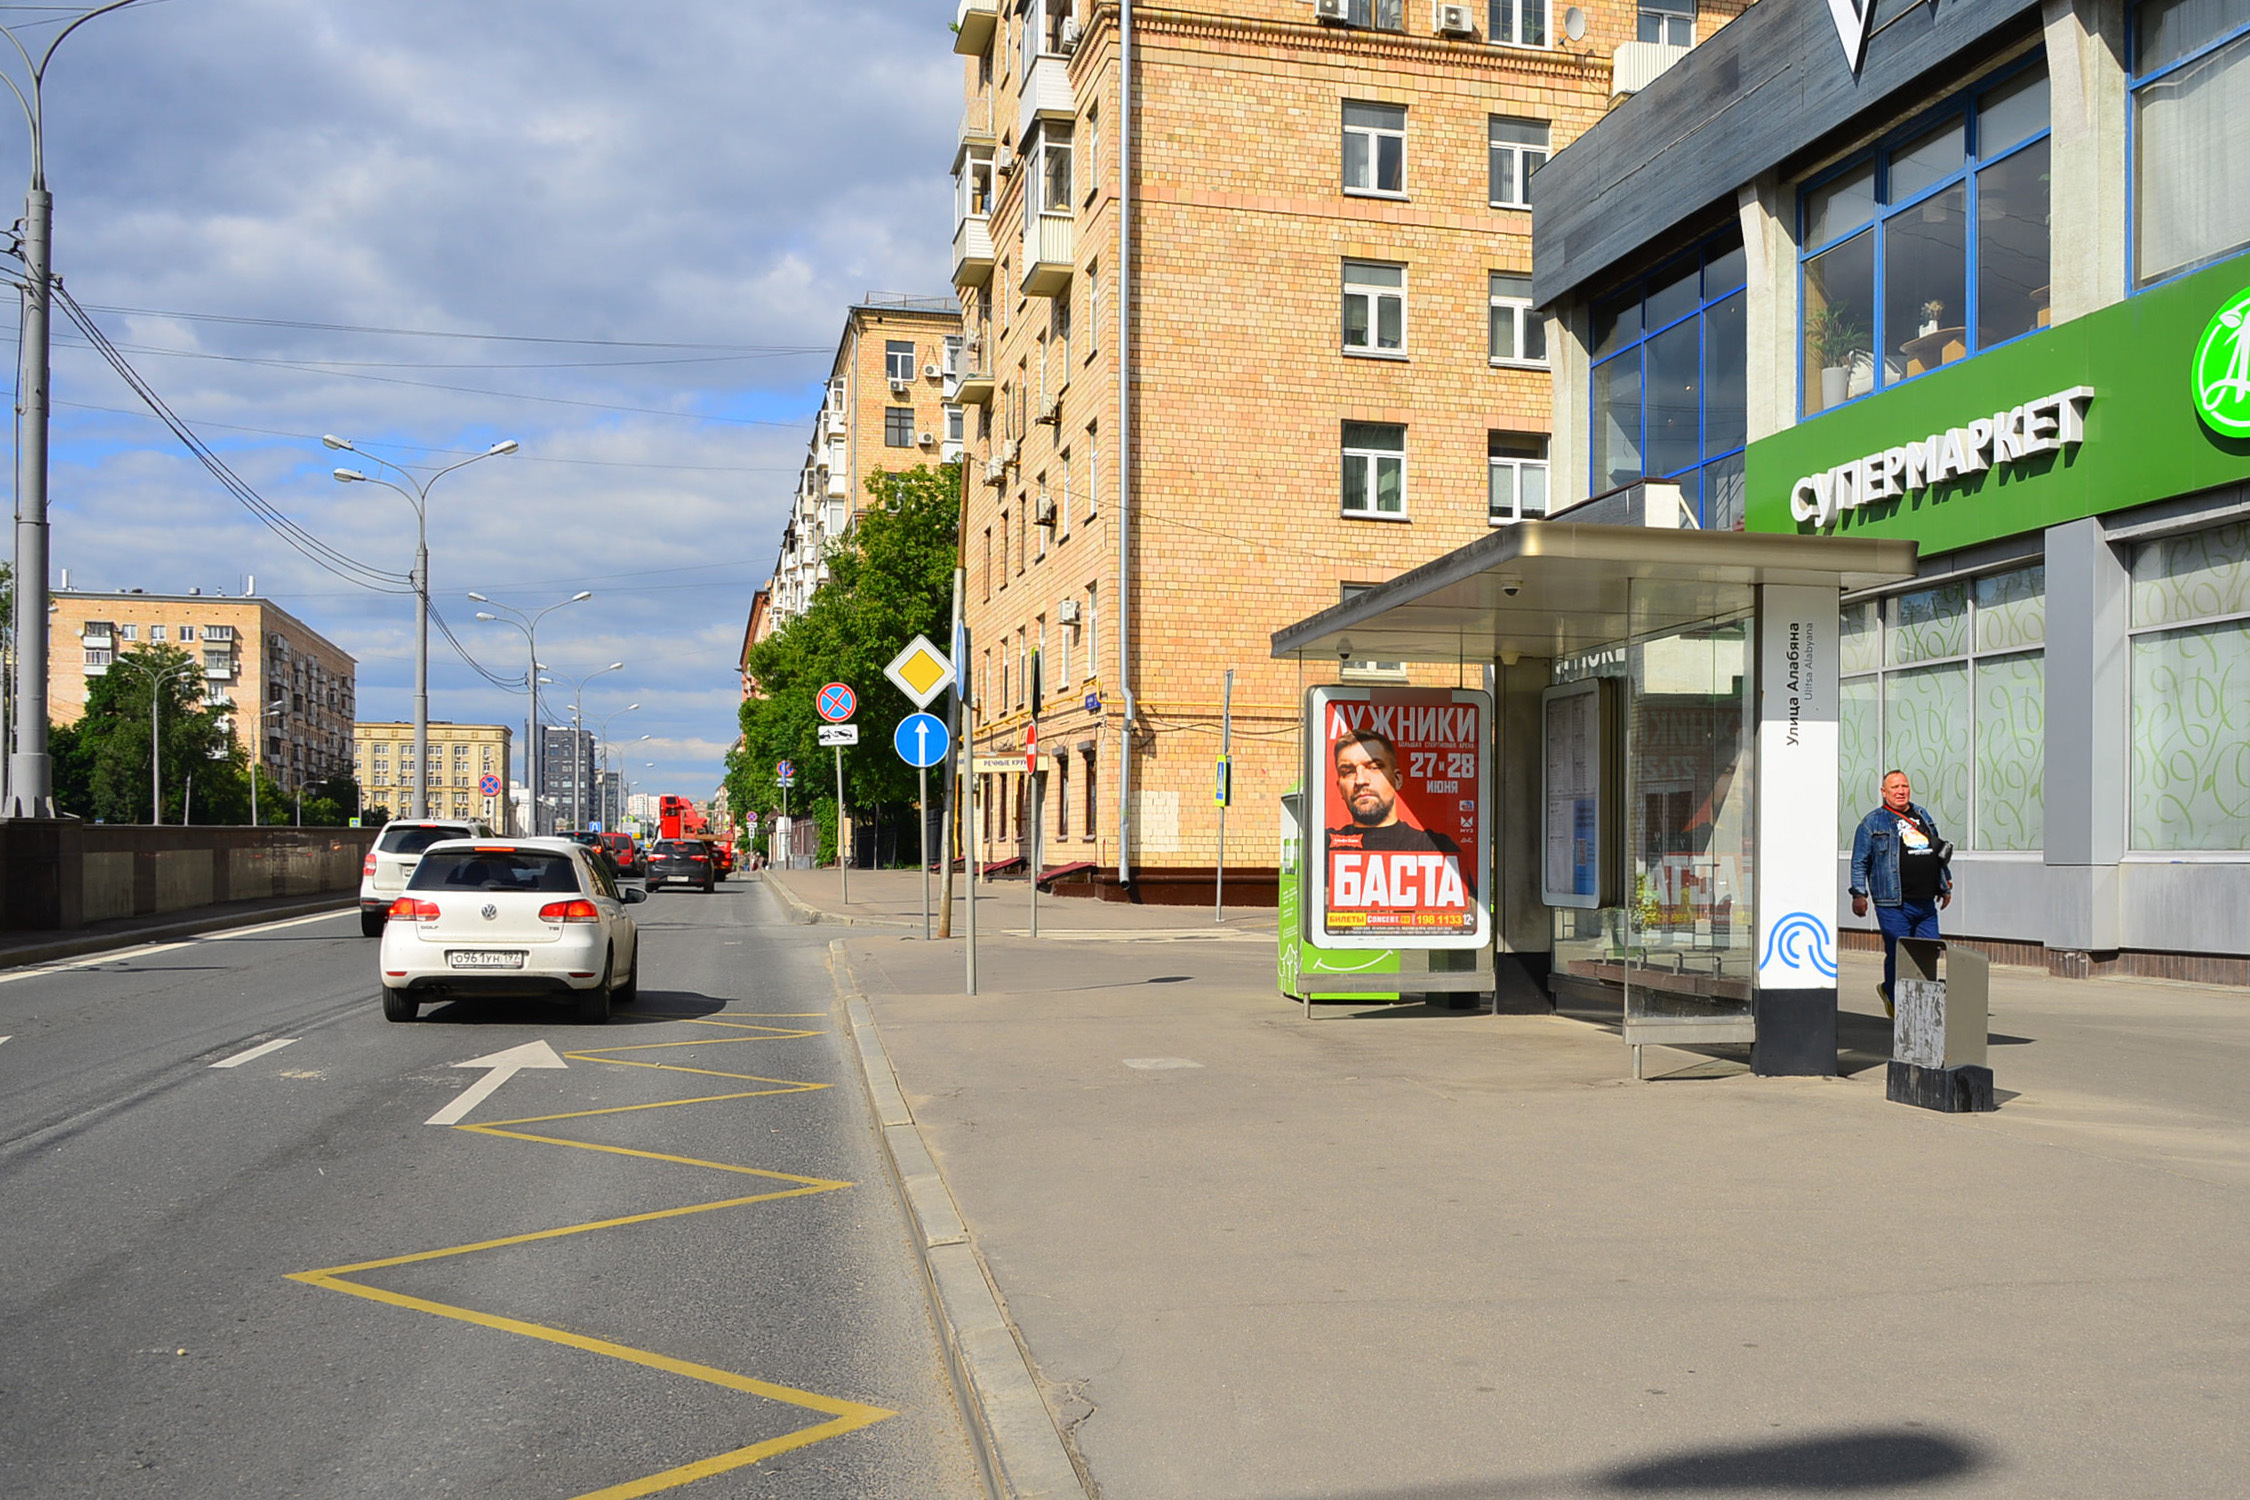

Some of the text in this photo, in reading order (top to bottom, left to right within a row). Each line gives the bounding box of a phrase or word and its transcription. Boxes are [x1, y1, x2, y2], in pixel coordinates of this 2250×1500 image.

[1790, 385, 2095, 528] СУПЕРМАРКЕТ
[1804, 622, 1815, 701] Ulitsa Alabyana
[1786, 622, 1801, 746] Улица Алабяна
[1329, 704, 1476, 742] ЛУЖНИКИ
[1410, 752, 1438, 778] 27
[1447, 753, 1475, 779] 28
[1426, 780, 1458, 794] ИЮНЯ
[1333, 854, 1466, 907] БАСТА
[1329, 915, 1365, 924] БИЛЕТЫ
[1416, 914, 1435, 925] 198
[1437, 915, 1463, 925] 1133
[1463, 913, 1474, 926] 12+
